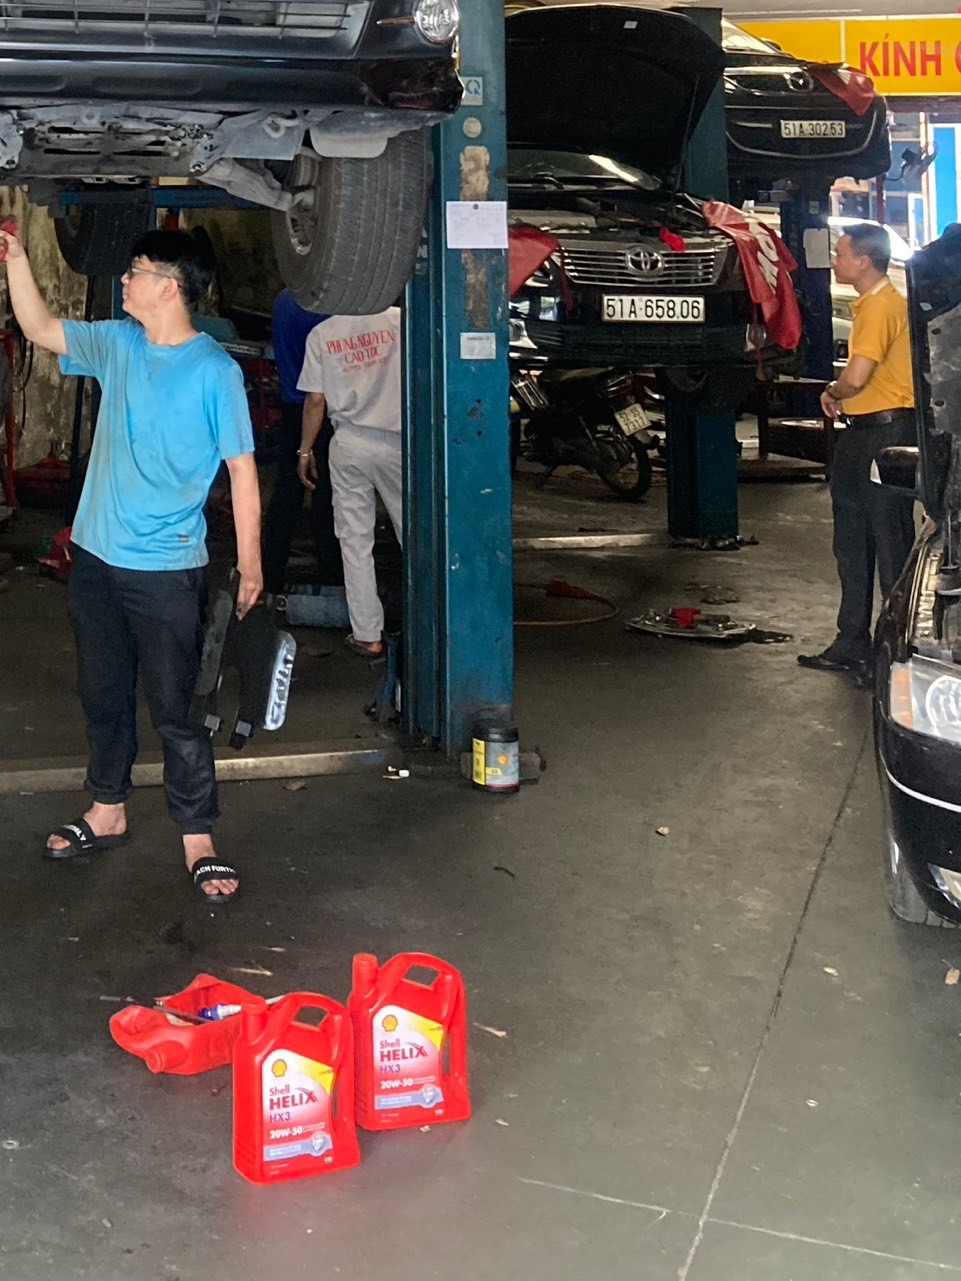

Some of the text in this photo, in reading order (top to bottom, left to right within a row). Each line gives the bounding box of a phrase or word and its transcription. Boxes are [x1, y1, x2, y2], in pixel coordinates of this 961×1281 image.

[859, 32, 942, 77] KÍNH
[380, 1038, 400, 1049] Shell
[379, 1042, 428, 1062] HELIX
[380, 1064, 401, 1074] HX3
[269, 1084, 290, 1096] Shell
[269, 1088, 318, 1110] HELIX
[269, 1112, 291, 1123] HX3
